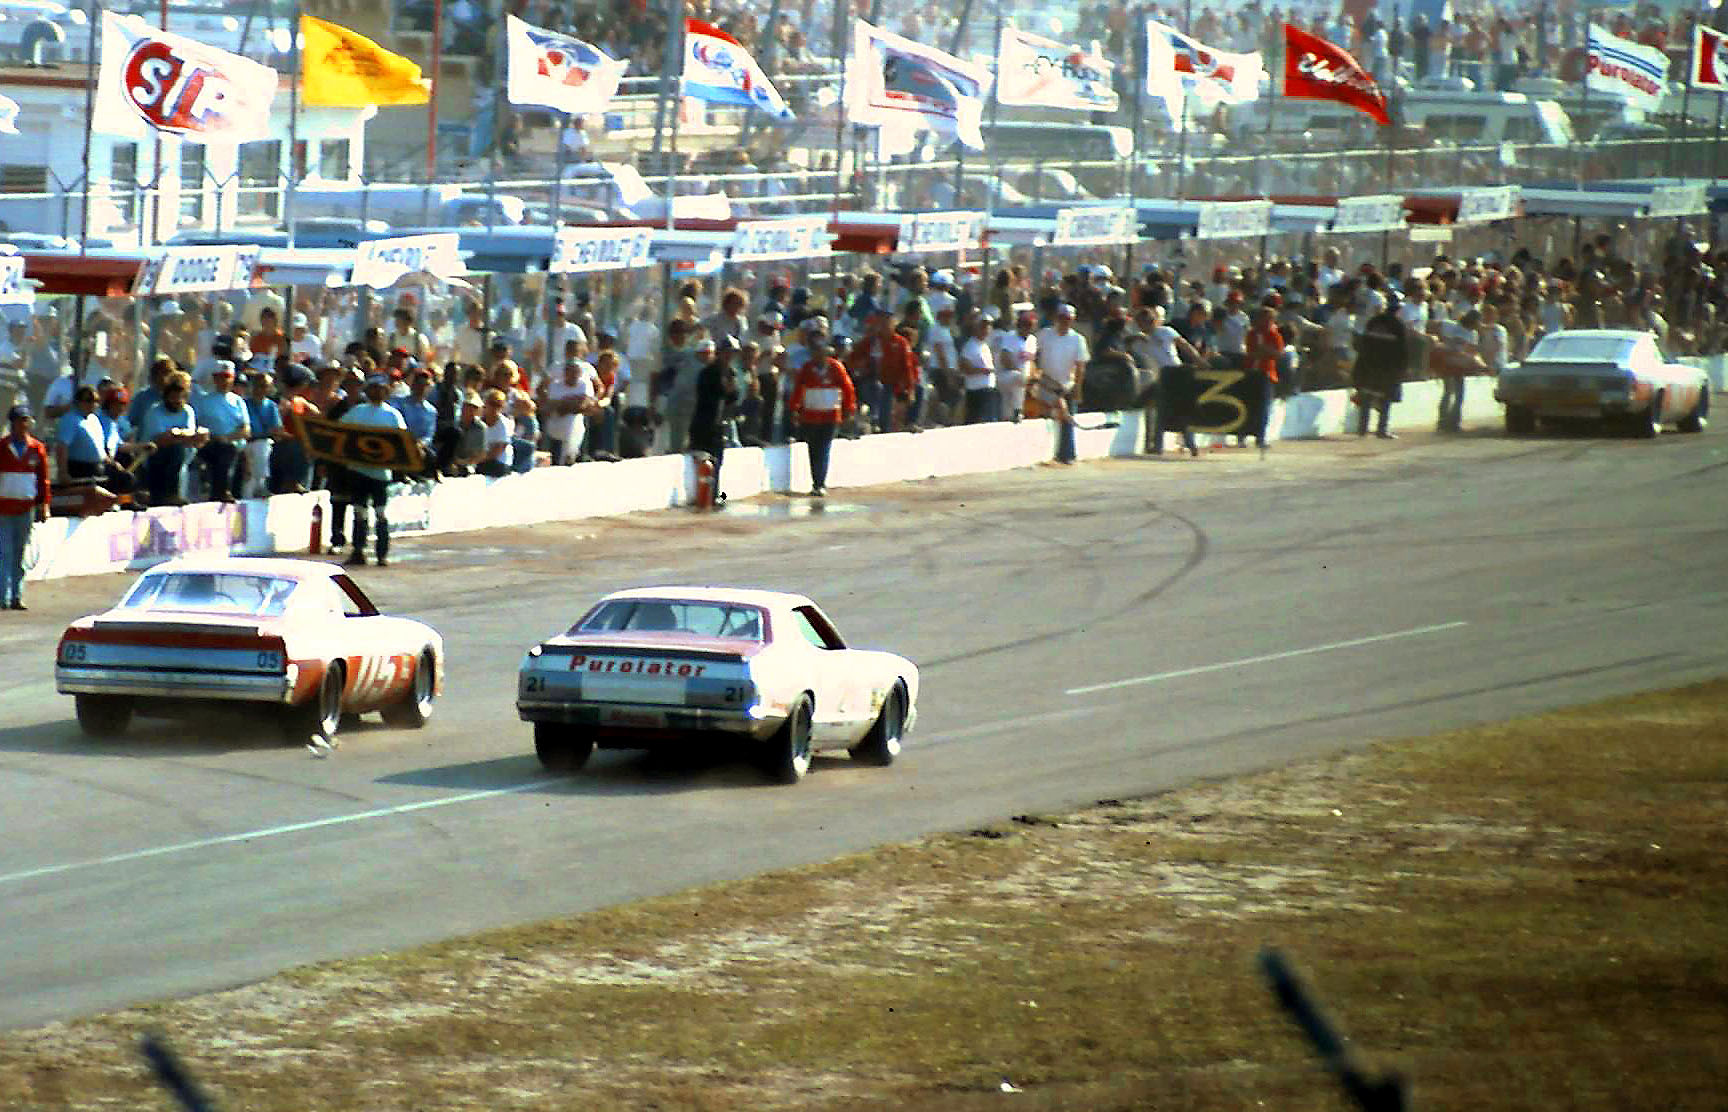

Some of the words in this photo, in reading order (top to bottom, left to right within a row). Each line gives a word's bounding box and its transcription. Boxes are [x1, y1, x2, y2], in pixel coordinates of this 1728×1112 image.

[173, 256, 220, 284] DODGE
[1187, 371, 1248, 432] 3
[64, 644, 87, 660] 05
[257, 652, 278, 669] 05
[570, 655, 705, 676] Purolator
[527, 676, 546, 692] 21
[725, 687, 743, 702] 21
